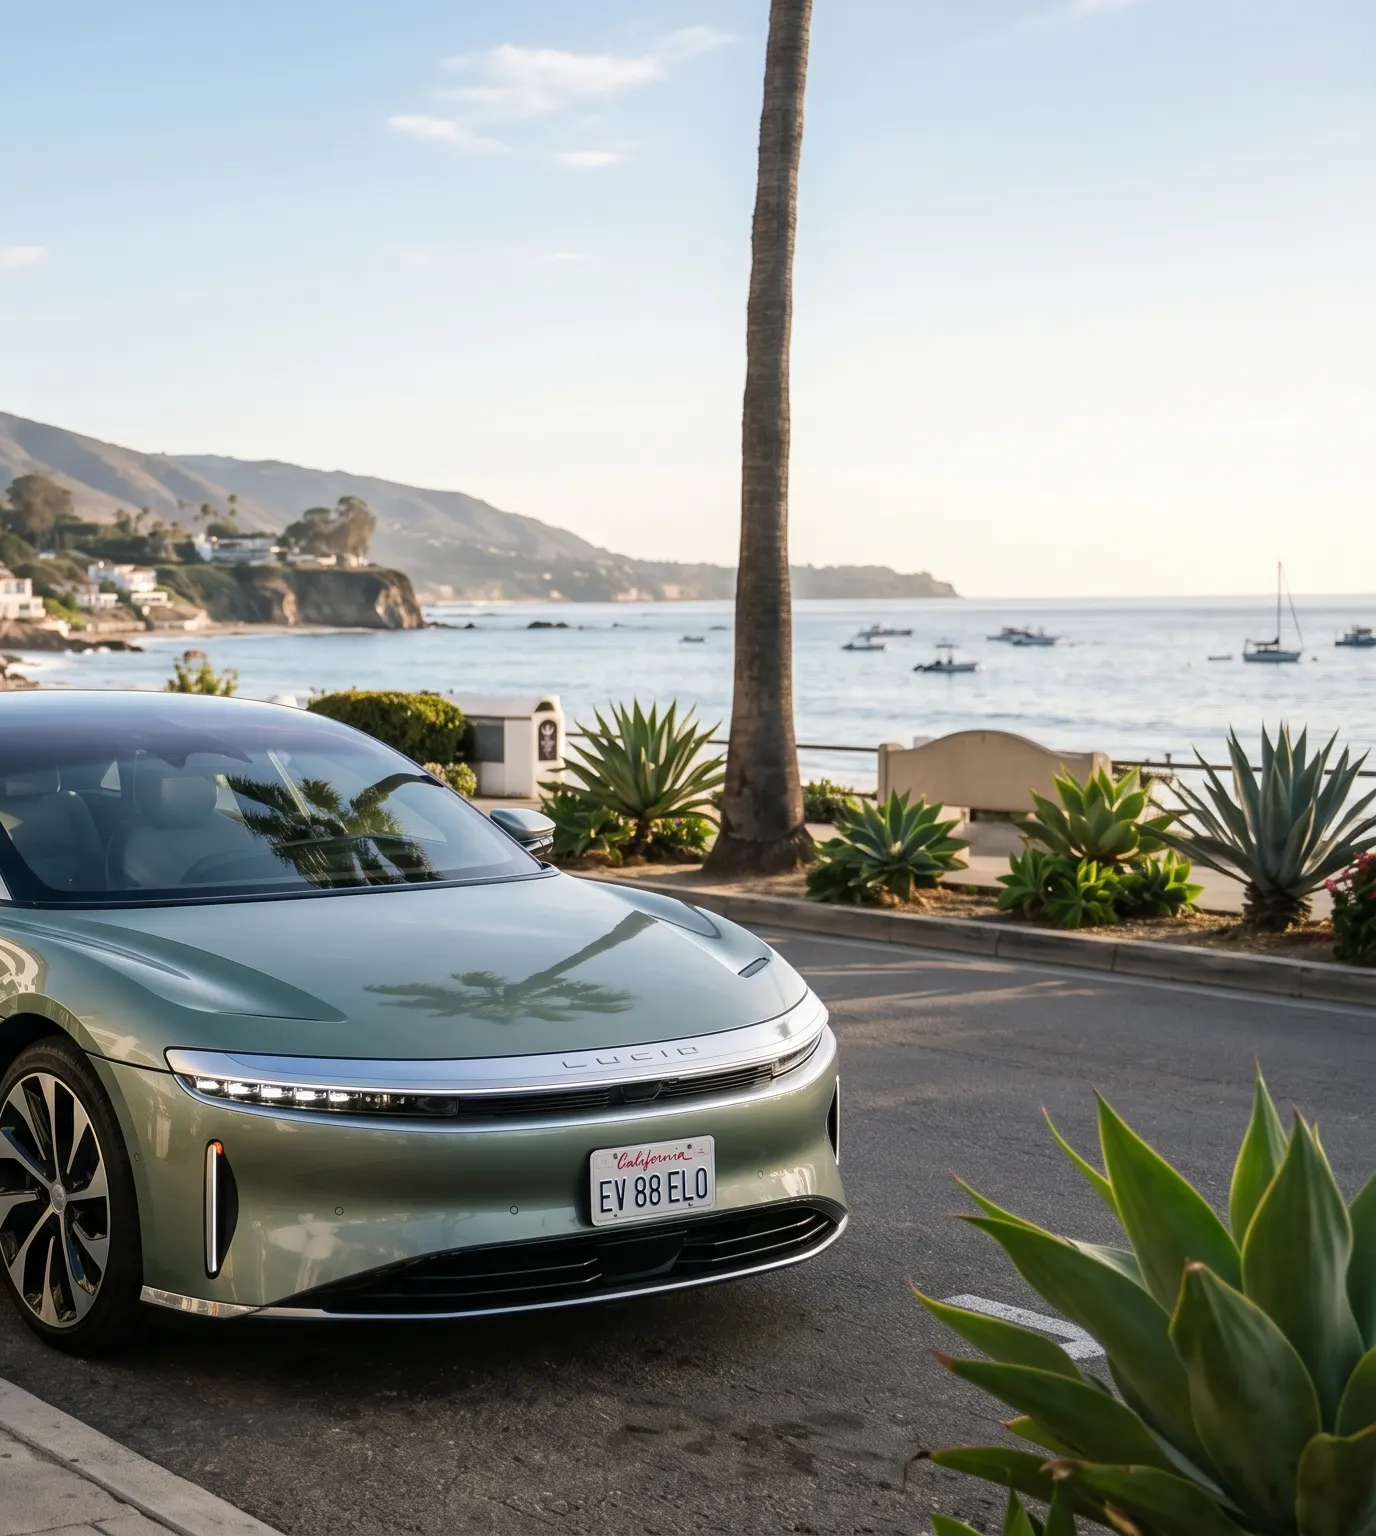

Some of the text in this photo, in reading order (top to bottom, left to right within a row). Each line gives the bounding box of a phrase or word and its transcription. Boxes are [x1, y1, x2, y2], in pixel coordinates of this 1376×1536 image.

[562, 1046, 700, 1069] LUCID
[617, 1149, 693, 1171] California
[599, 1177, 627, 1214] EV
[634, 1173, 662, 1208] 88
